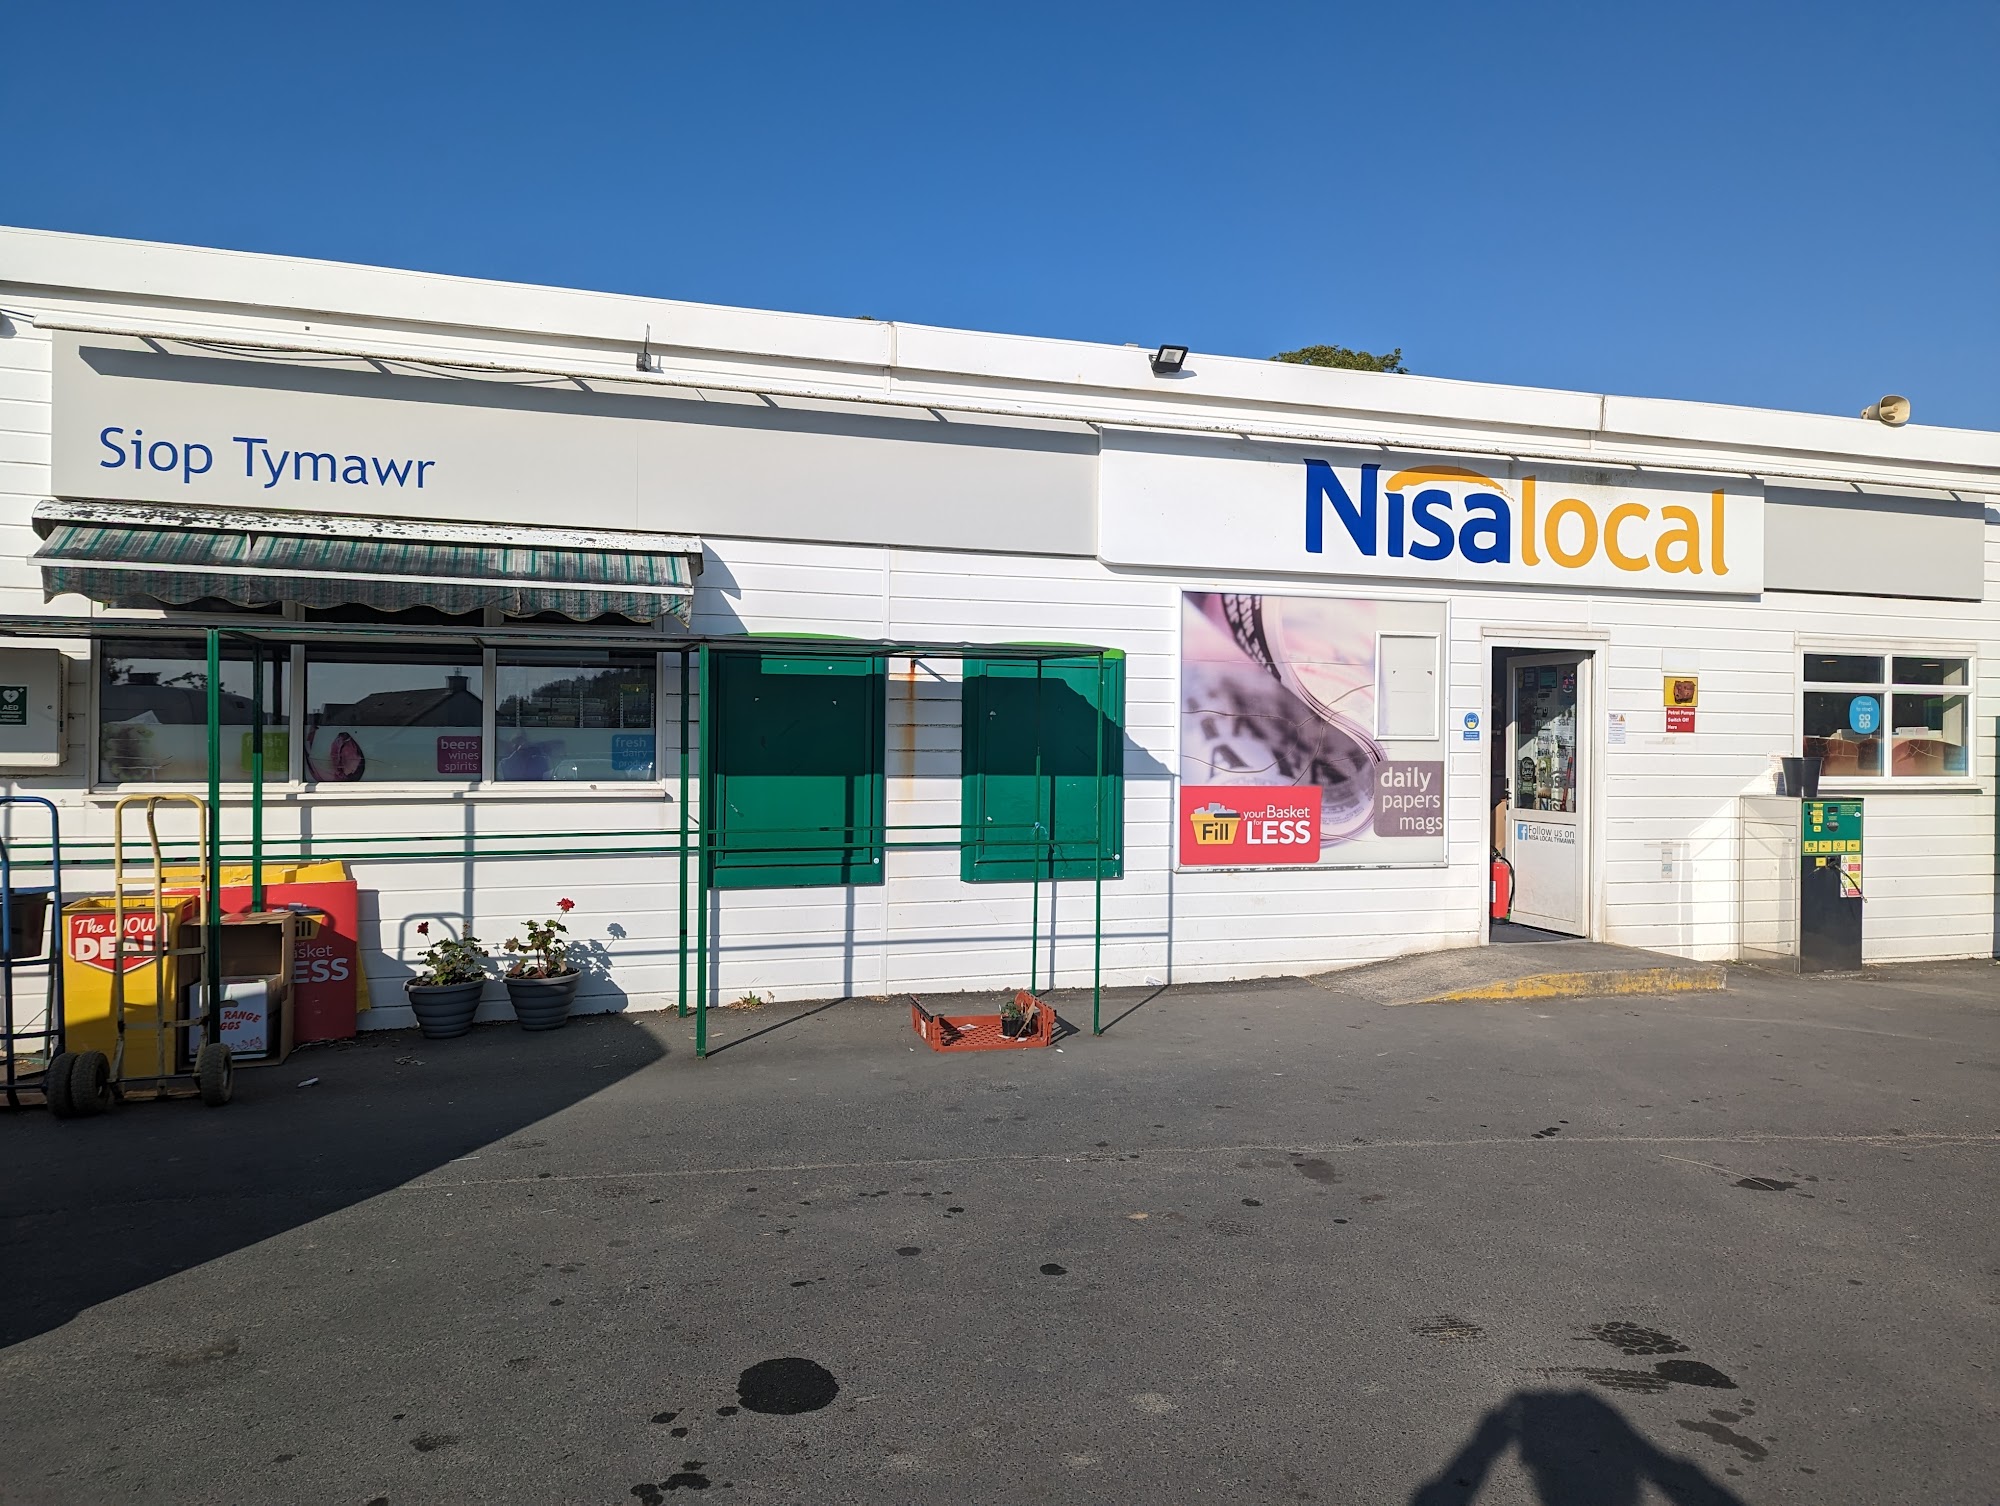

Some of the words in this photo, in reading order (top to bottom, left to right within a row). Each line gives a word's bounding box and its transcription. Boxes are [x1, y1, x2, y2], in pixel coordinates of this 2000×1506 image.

[100, 426, 213, 484] Siop
[232, 436, 436, 489] Tymawr
[441, 739, 478, 750] beers
[616, 737, 647, 748] fresh
[448, 751, 479, 760] wines
[622, 748, 648, 759] dairy
[444, 761, 478, 773] spirits
[1380, 766, 1432, 792] daily
[1382, 794, 1441, 813] papers
[1243, 810, 1266, 821] your
[1266, 804, 1311, 819] Basket
[1202, 821, 1229, 841] Fill
[1246, 820, 1311, 845] LESS
[1399, 816, 1443, 835] mags
[1528, 824, 1552, 836] Follow
[1554, 830, 1563, 838] us
[1564, 830, 1575, 839] on
[1540, 835, 1554, 843] LOCAL
[75, 918, 106, 935] The
[295, 919, 312, 937] ill
[294, 944, 334, 959] sket
[292, 957, 349, 984] ESS
[224, 1010, 262, 1023] RANGE
[219, 1021, 241, 1031] GGS
